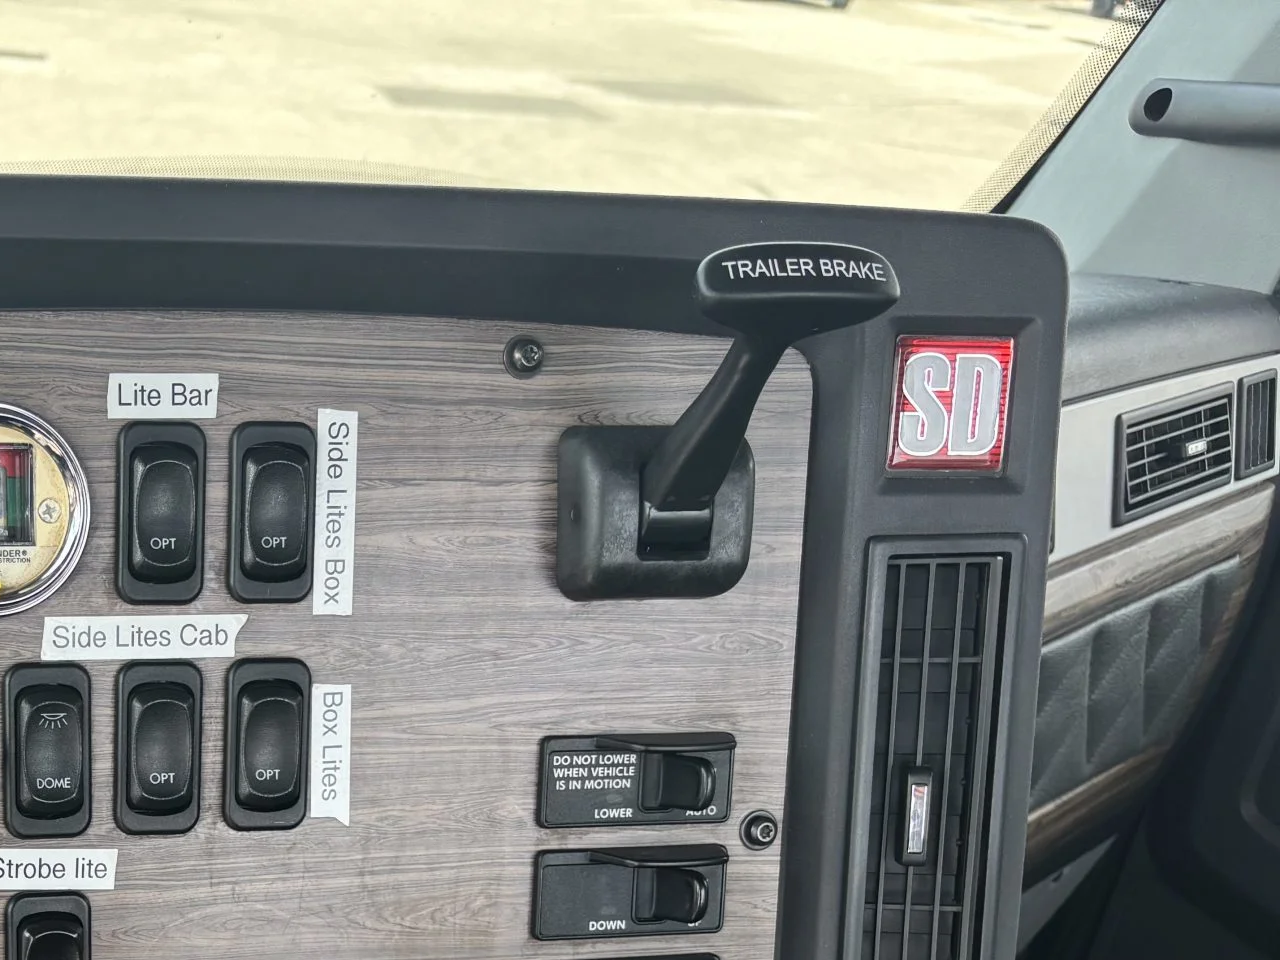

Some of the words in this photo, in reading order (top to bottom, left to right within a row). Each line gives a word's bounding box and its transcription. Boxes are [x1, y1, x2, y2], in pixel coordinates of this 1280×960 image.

[722, 258, 817, 280] TRAILER
[819, 259, 887, 282] BRAKE
[118, 383, 162, 407] Lite
[172, 381, 212, 406] Bar
[898, 352, 1002, 457] SD
[327, 422, 349, 480] Side
[325, 490, 346, 550] Lites
[150, 536, 176, 551] OPT
[261, 535, 287, 549] OPT
[324, 558, 346, 605] Box
[52, 625, 107, 649] Side
[115, 624, 171, 648] Lites
[179, 623, 229, 647] Cab
[322, 691, 344, 737] Box
[553, 755, 571, 766] DO
[572, 754, 598, 766] NOT
[599, 754, 637, 765] LOWER
[149, 772, 176, 785] OPT
[255, 768, 280, 782] OPT
[322, 746, 342, 801] Lites
[553, 768, 588, 778] WHEN
[590, 766, 635, 777] VEHICLE
[36, 776, 71, 790] DOME
[556, 780, 567, 791] IS
[569, 779, 582, 790] IN
[584, 778, 631, 790] MOTION
[594, 808, 633, 819] LOWER
[74, 856, 108, 880] lite
[589, 920, 626, 931] DOWN
